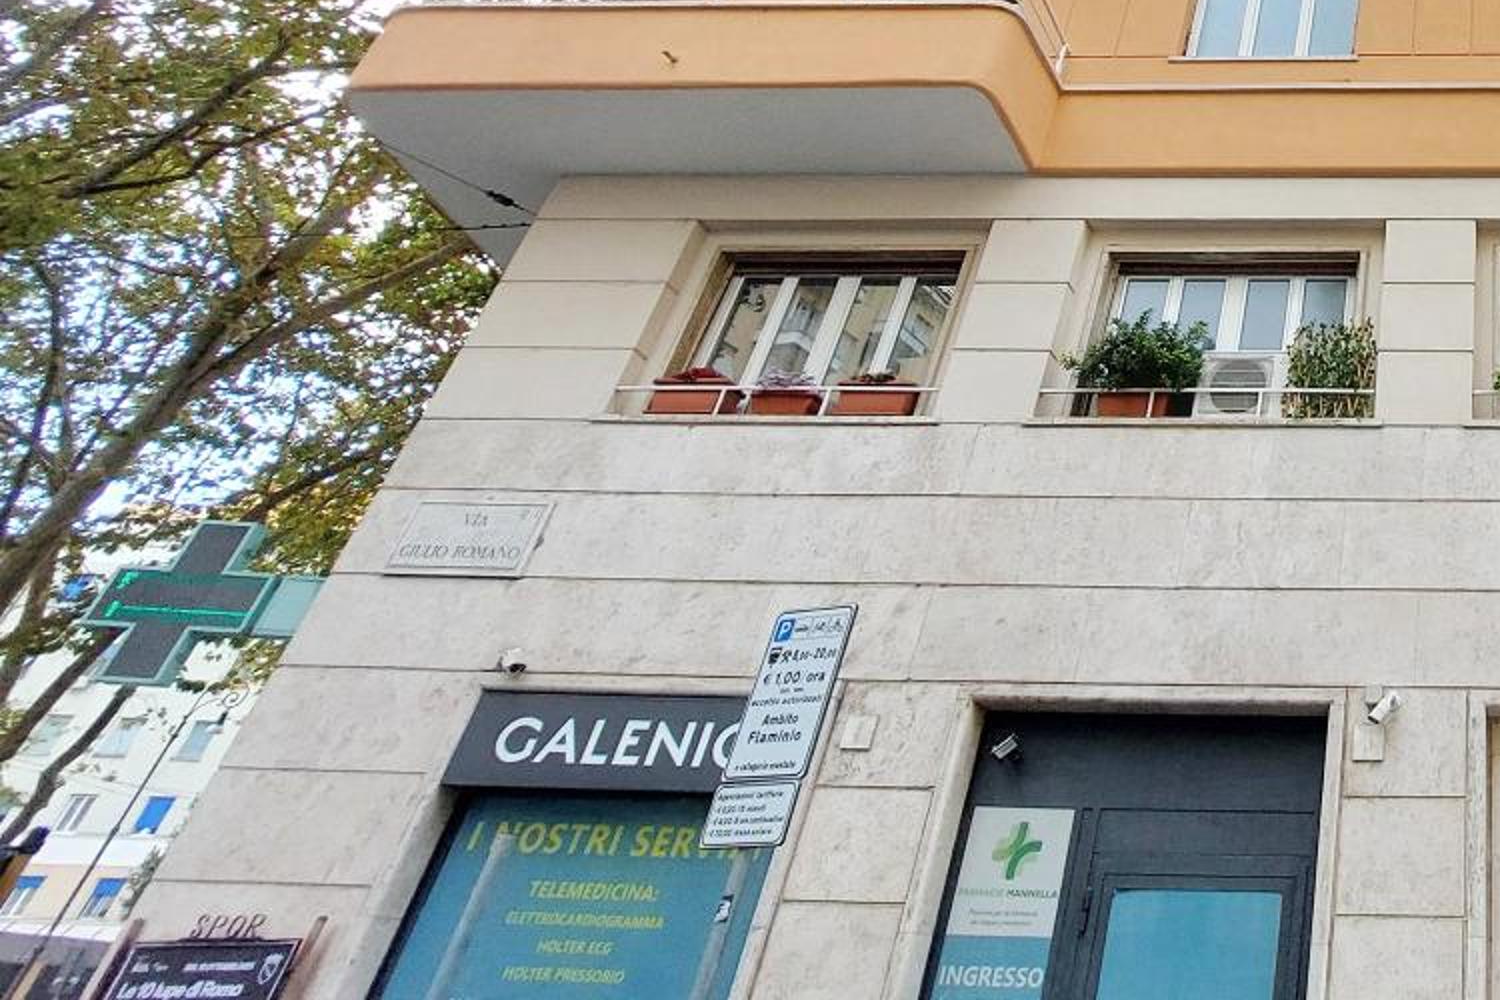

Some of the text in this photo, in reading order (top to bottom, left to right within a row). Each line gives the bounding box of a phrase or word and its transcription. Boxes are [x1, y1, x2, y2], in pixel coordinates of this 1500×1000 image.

[464, 512, 489, 527] VIA
[399, 544, 522, 561] GIULIO ROMANO
[761, 713, 799, 726] Ambito
[746, 730, 802, 745] Flaminio
[501, 966, 626, 984] HOLTER PRESSORIO
[938, 966, 1045, 988] INGRESSO
